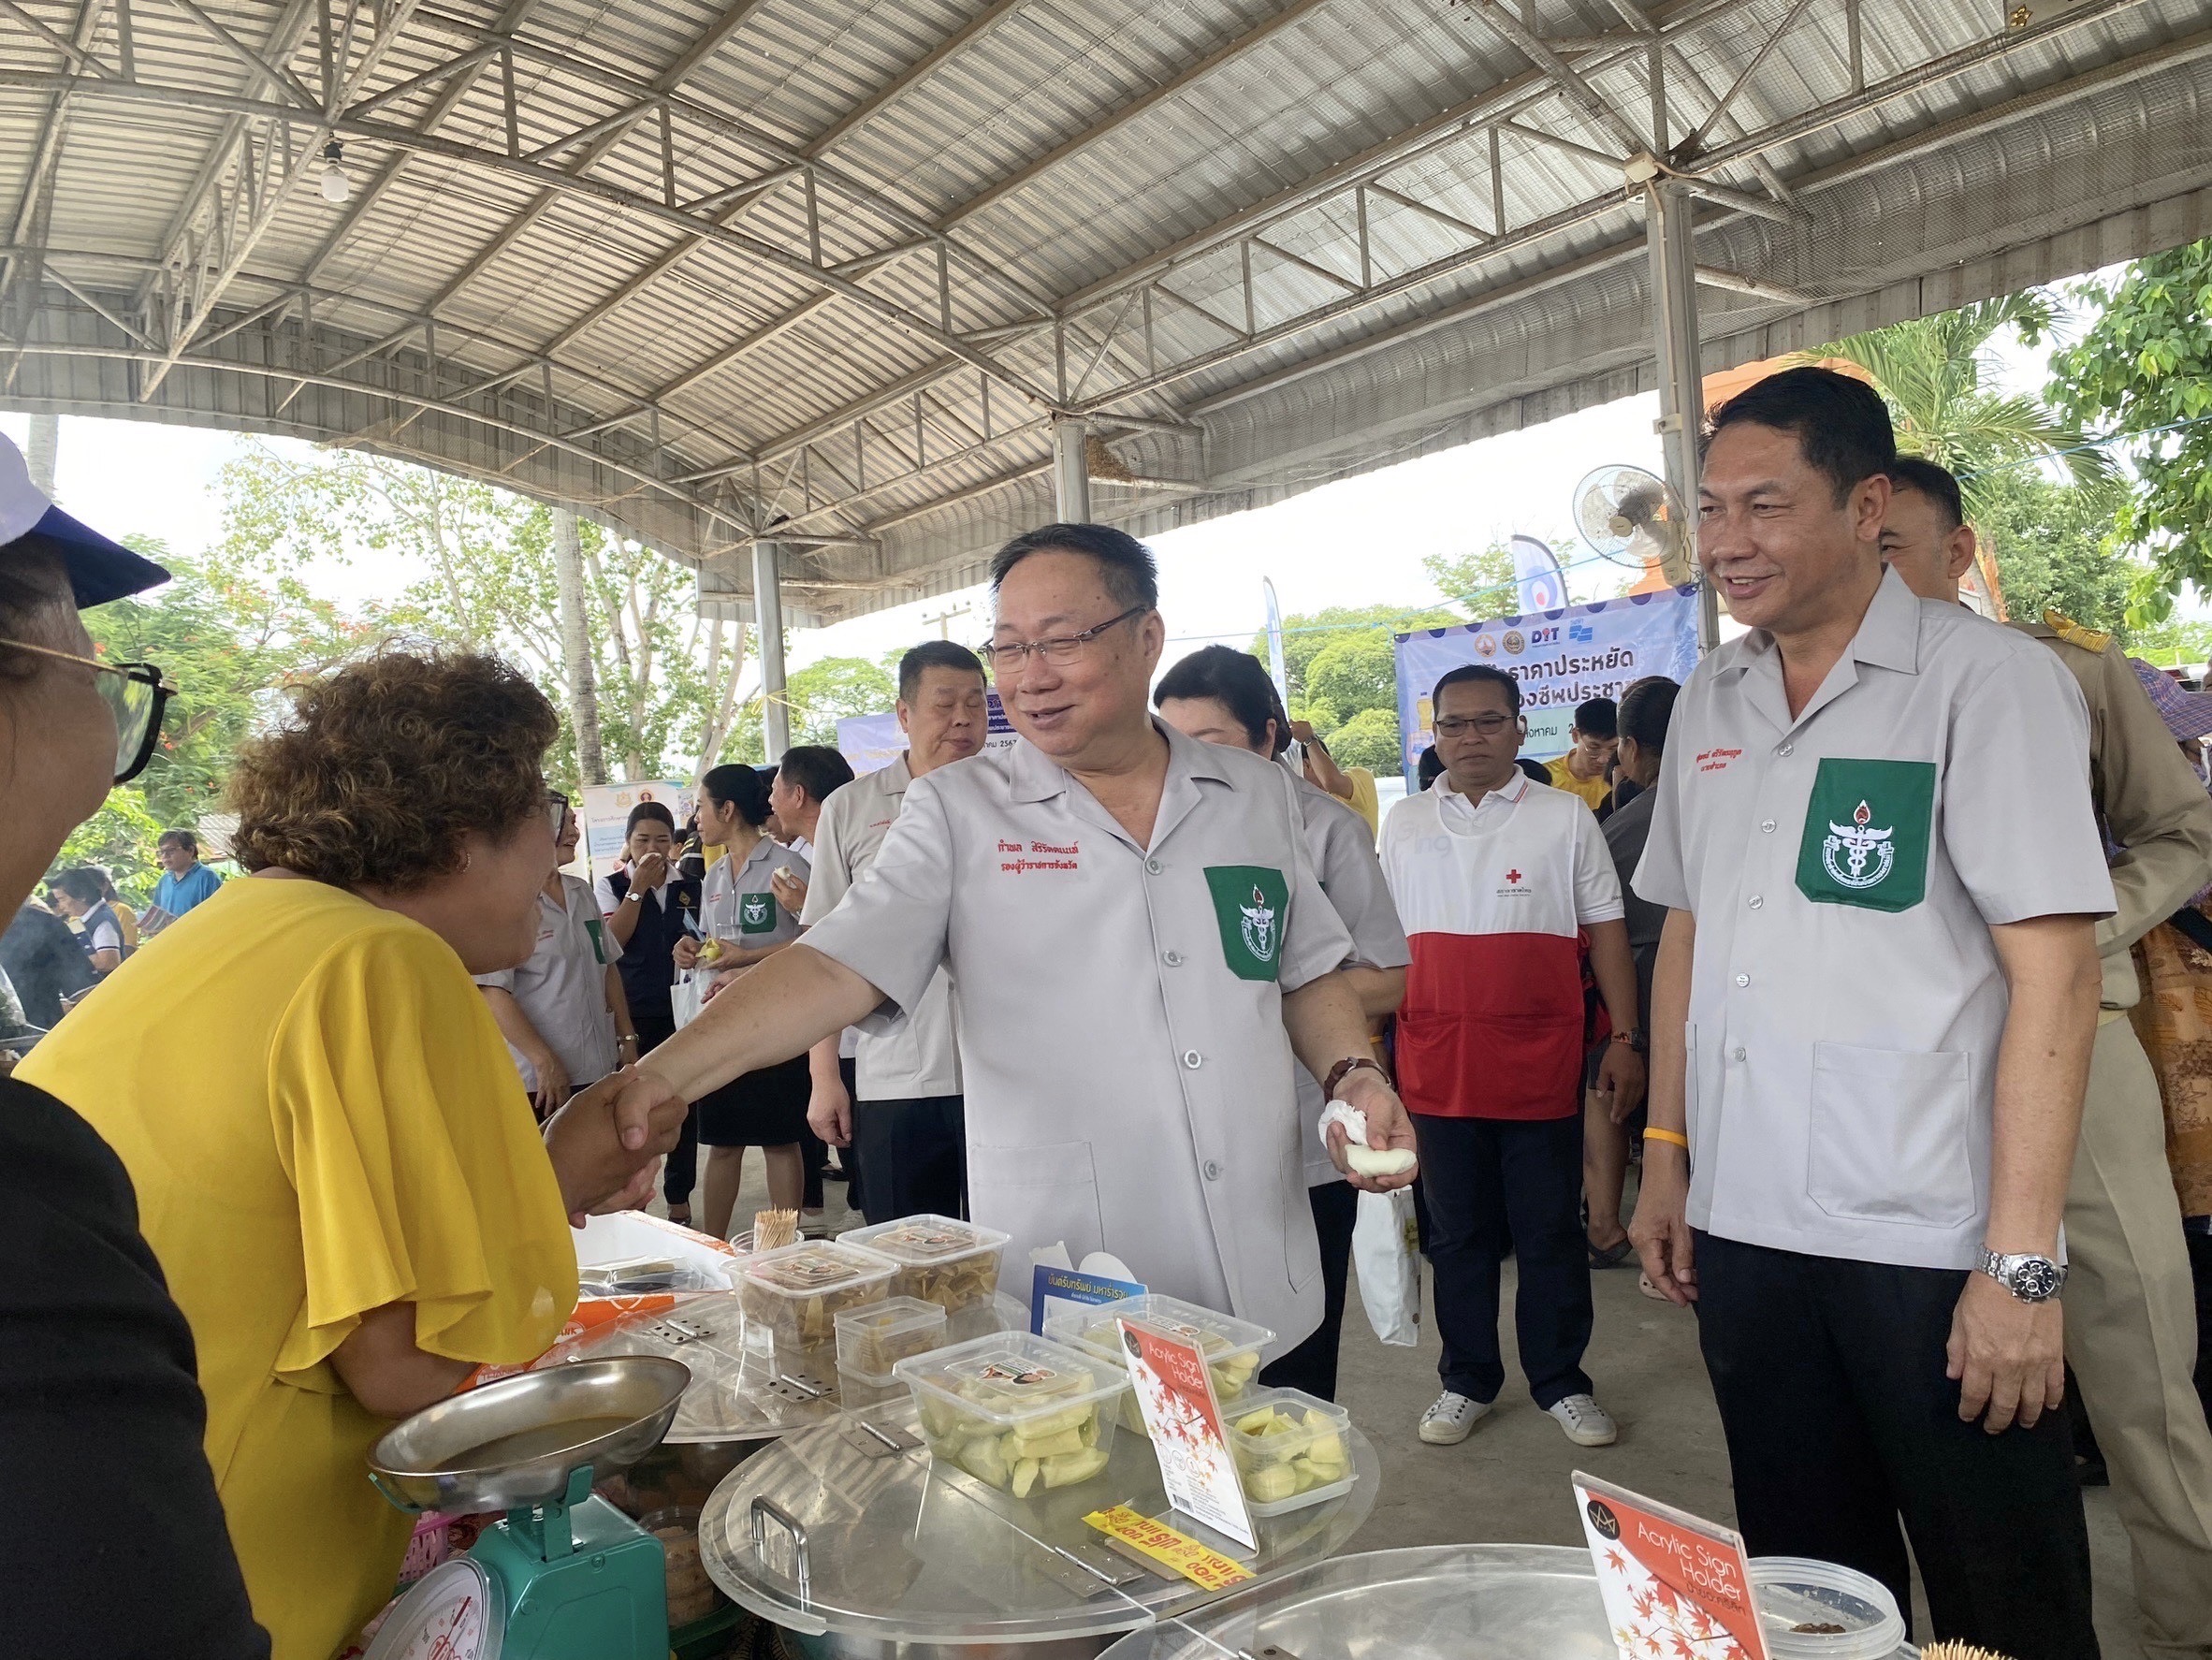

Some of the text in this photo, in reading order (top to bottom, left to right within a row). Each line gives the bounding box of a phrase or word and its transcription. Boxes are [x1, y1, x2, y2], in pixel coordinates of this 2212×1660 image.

[1486, 646, 1636, 682] ราคาประหยัด
[1525, 726, 1558, 738] งหาคม
[997, 838, 1023, 852] กำพล
[1177, 1352, 1201, 1374] Sign
[1171, 1364, 1203, 1390] Holder
[1638, 1521, 1737, 1579] Acrylic Sign
[1680, 1558, 1741, 1602] Holder
